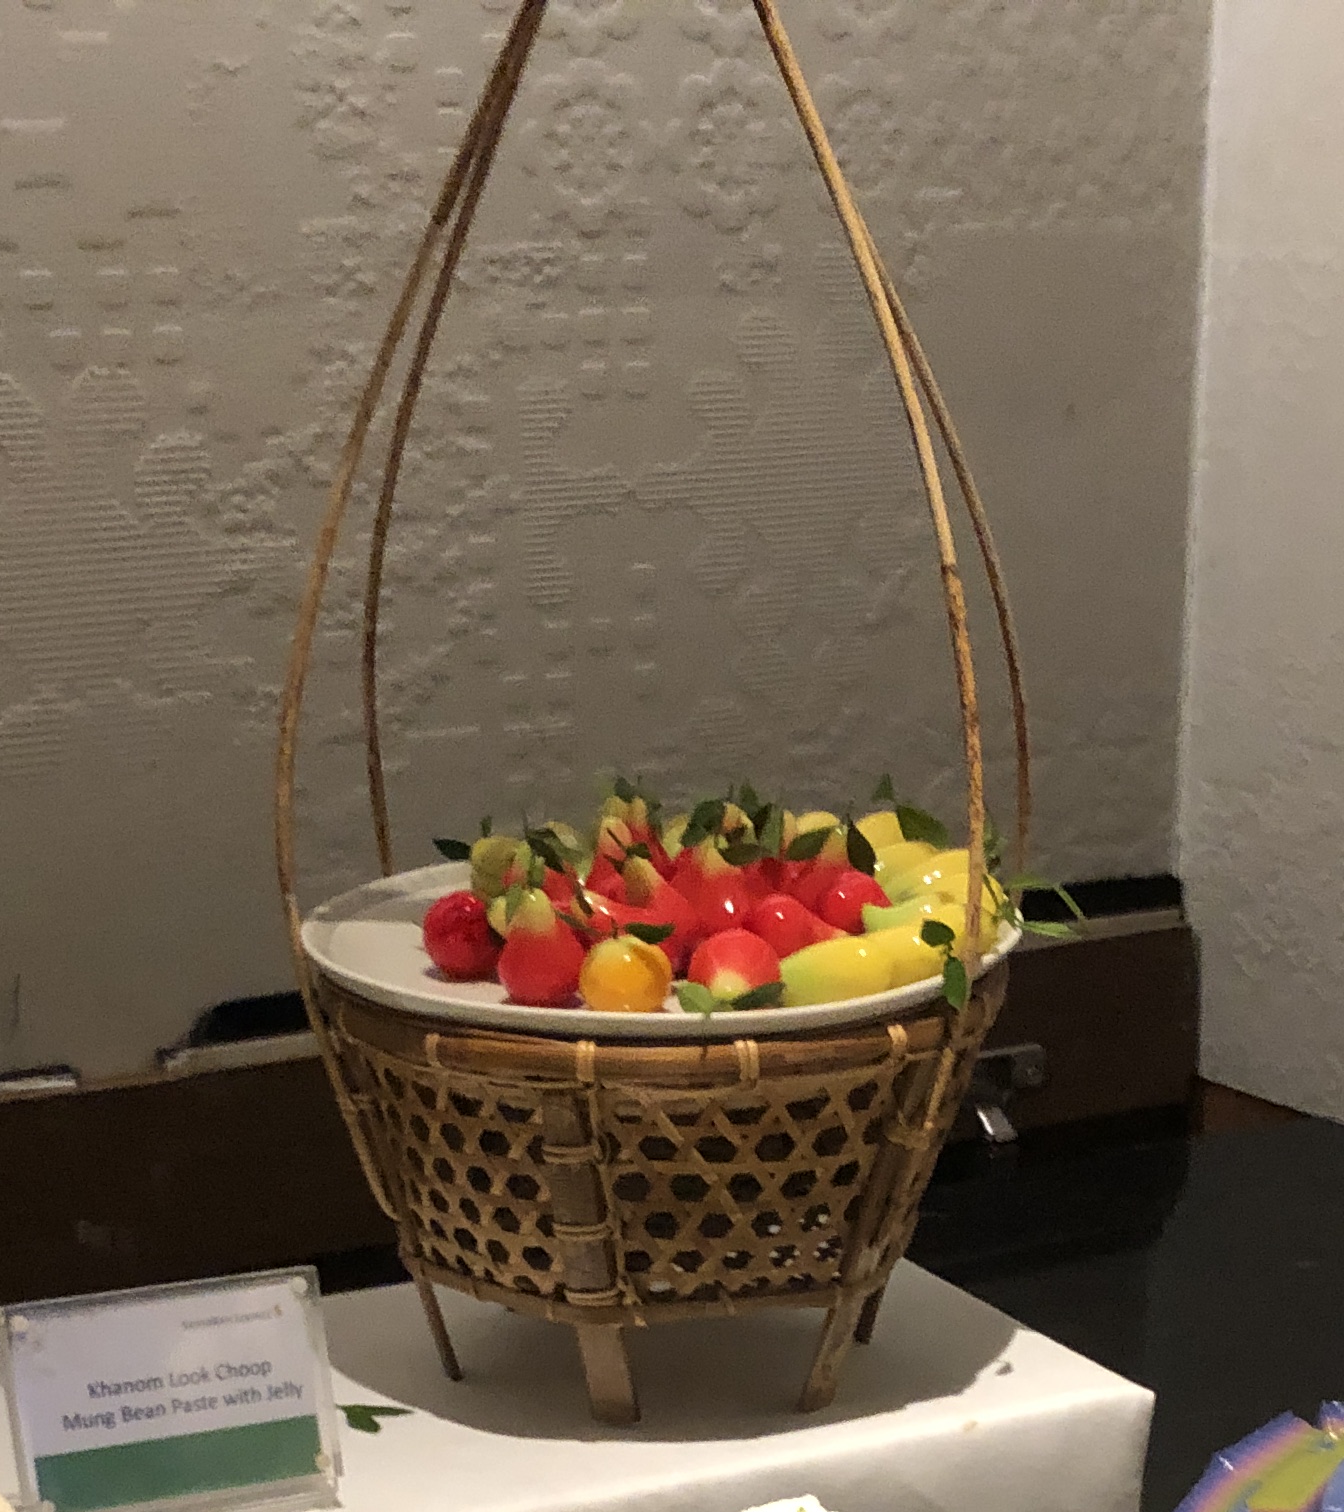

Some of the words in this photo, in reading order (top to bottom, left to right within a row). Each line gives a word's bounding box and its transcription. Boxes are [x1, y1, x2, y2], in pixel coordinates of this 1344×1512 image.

[87, 1375, 164, 1399] Khanom
[168, 1367, 210, 1389] Look
[214, 1359, 273, 1381] Choop
[61, 1410, 116, 1432] Mung
[121, 1402, 167, 1424] Bean
[171, 1395, 219, 1415] Paste
[222, 1387, 262, 1407] with
[266, 1379, 304, 1402] Jelly
